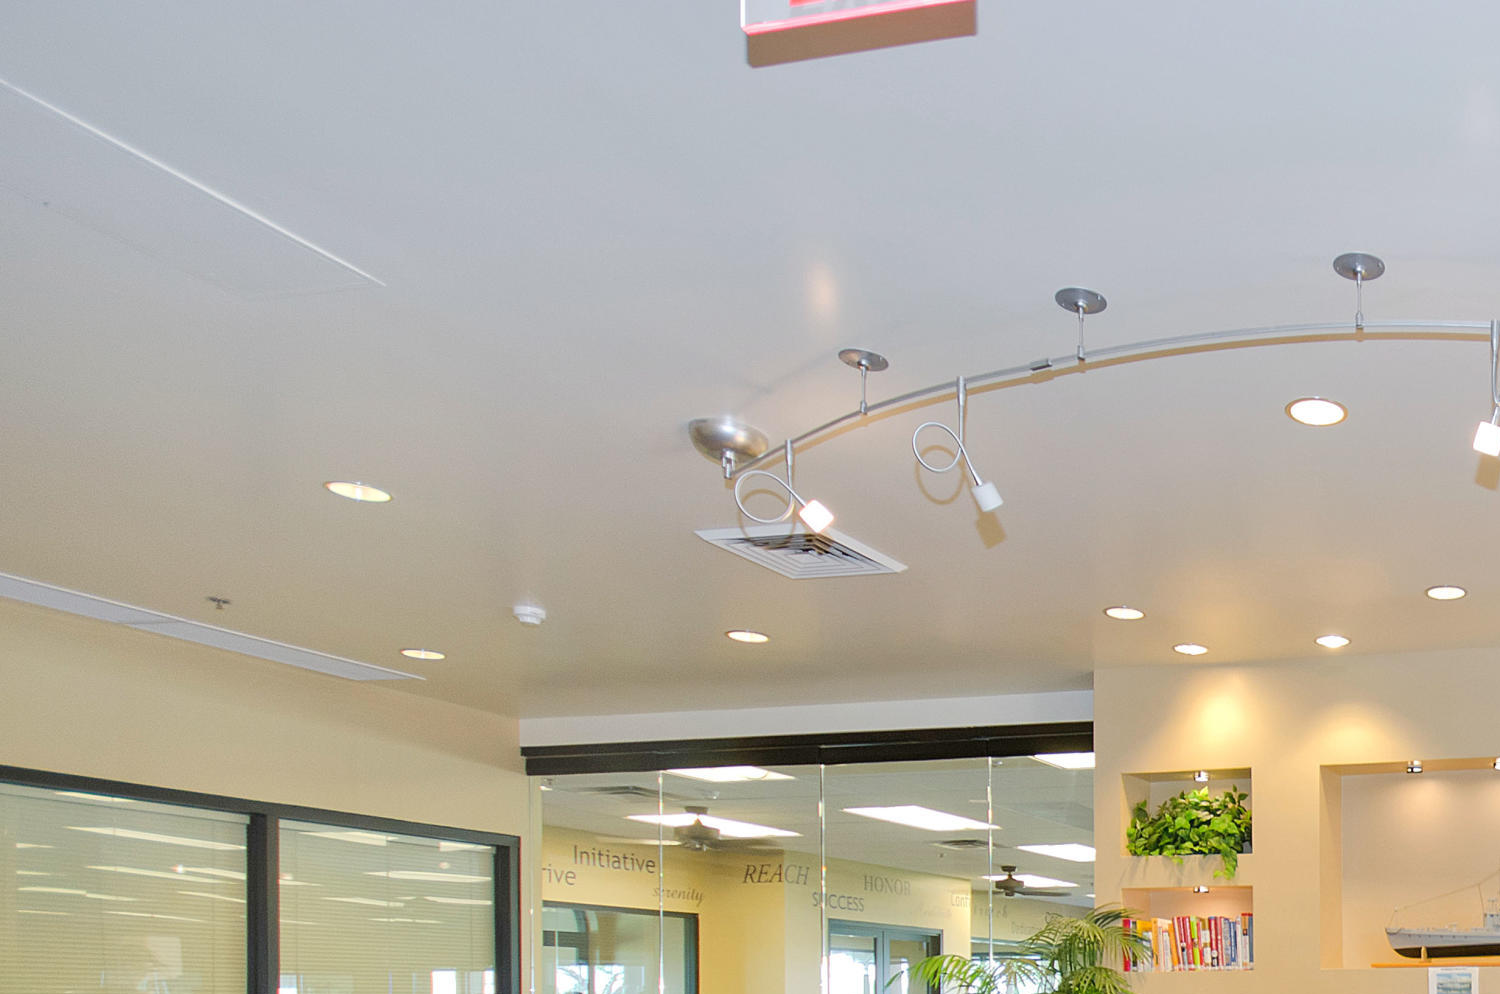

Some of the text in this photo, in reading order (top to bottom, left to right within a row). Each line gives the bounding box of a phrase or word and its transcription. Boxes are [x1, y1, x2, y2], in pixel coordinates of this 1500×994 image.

[573, 845, 656, 874] Initiative
[743, 863, 810, 885] REACH
[863, 874, 911, 896] HONOR
[812, 891, 864, 912] SUCCESS
